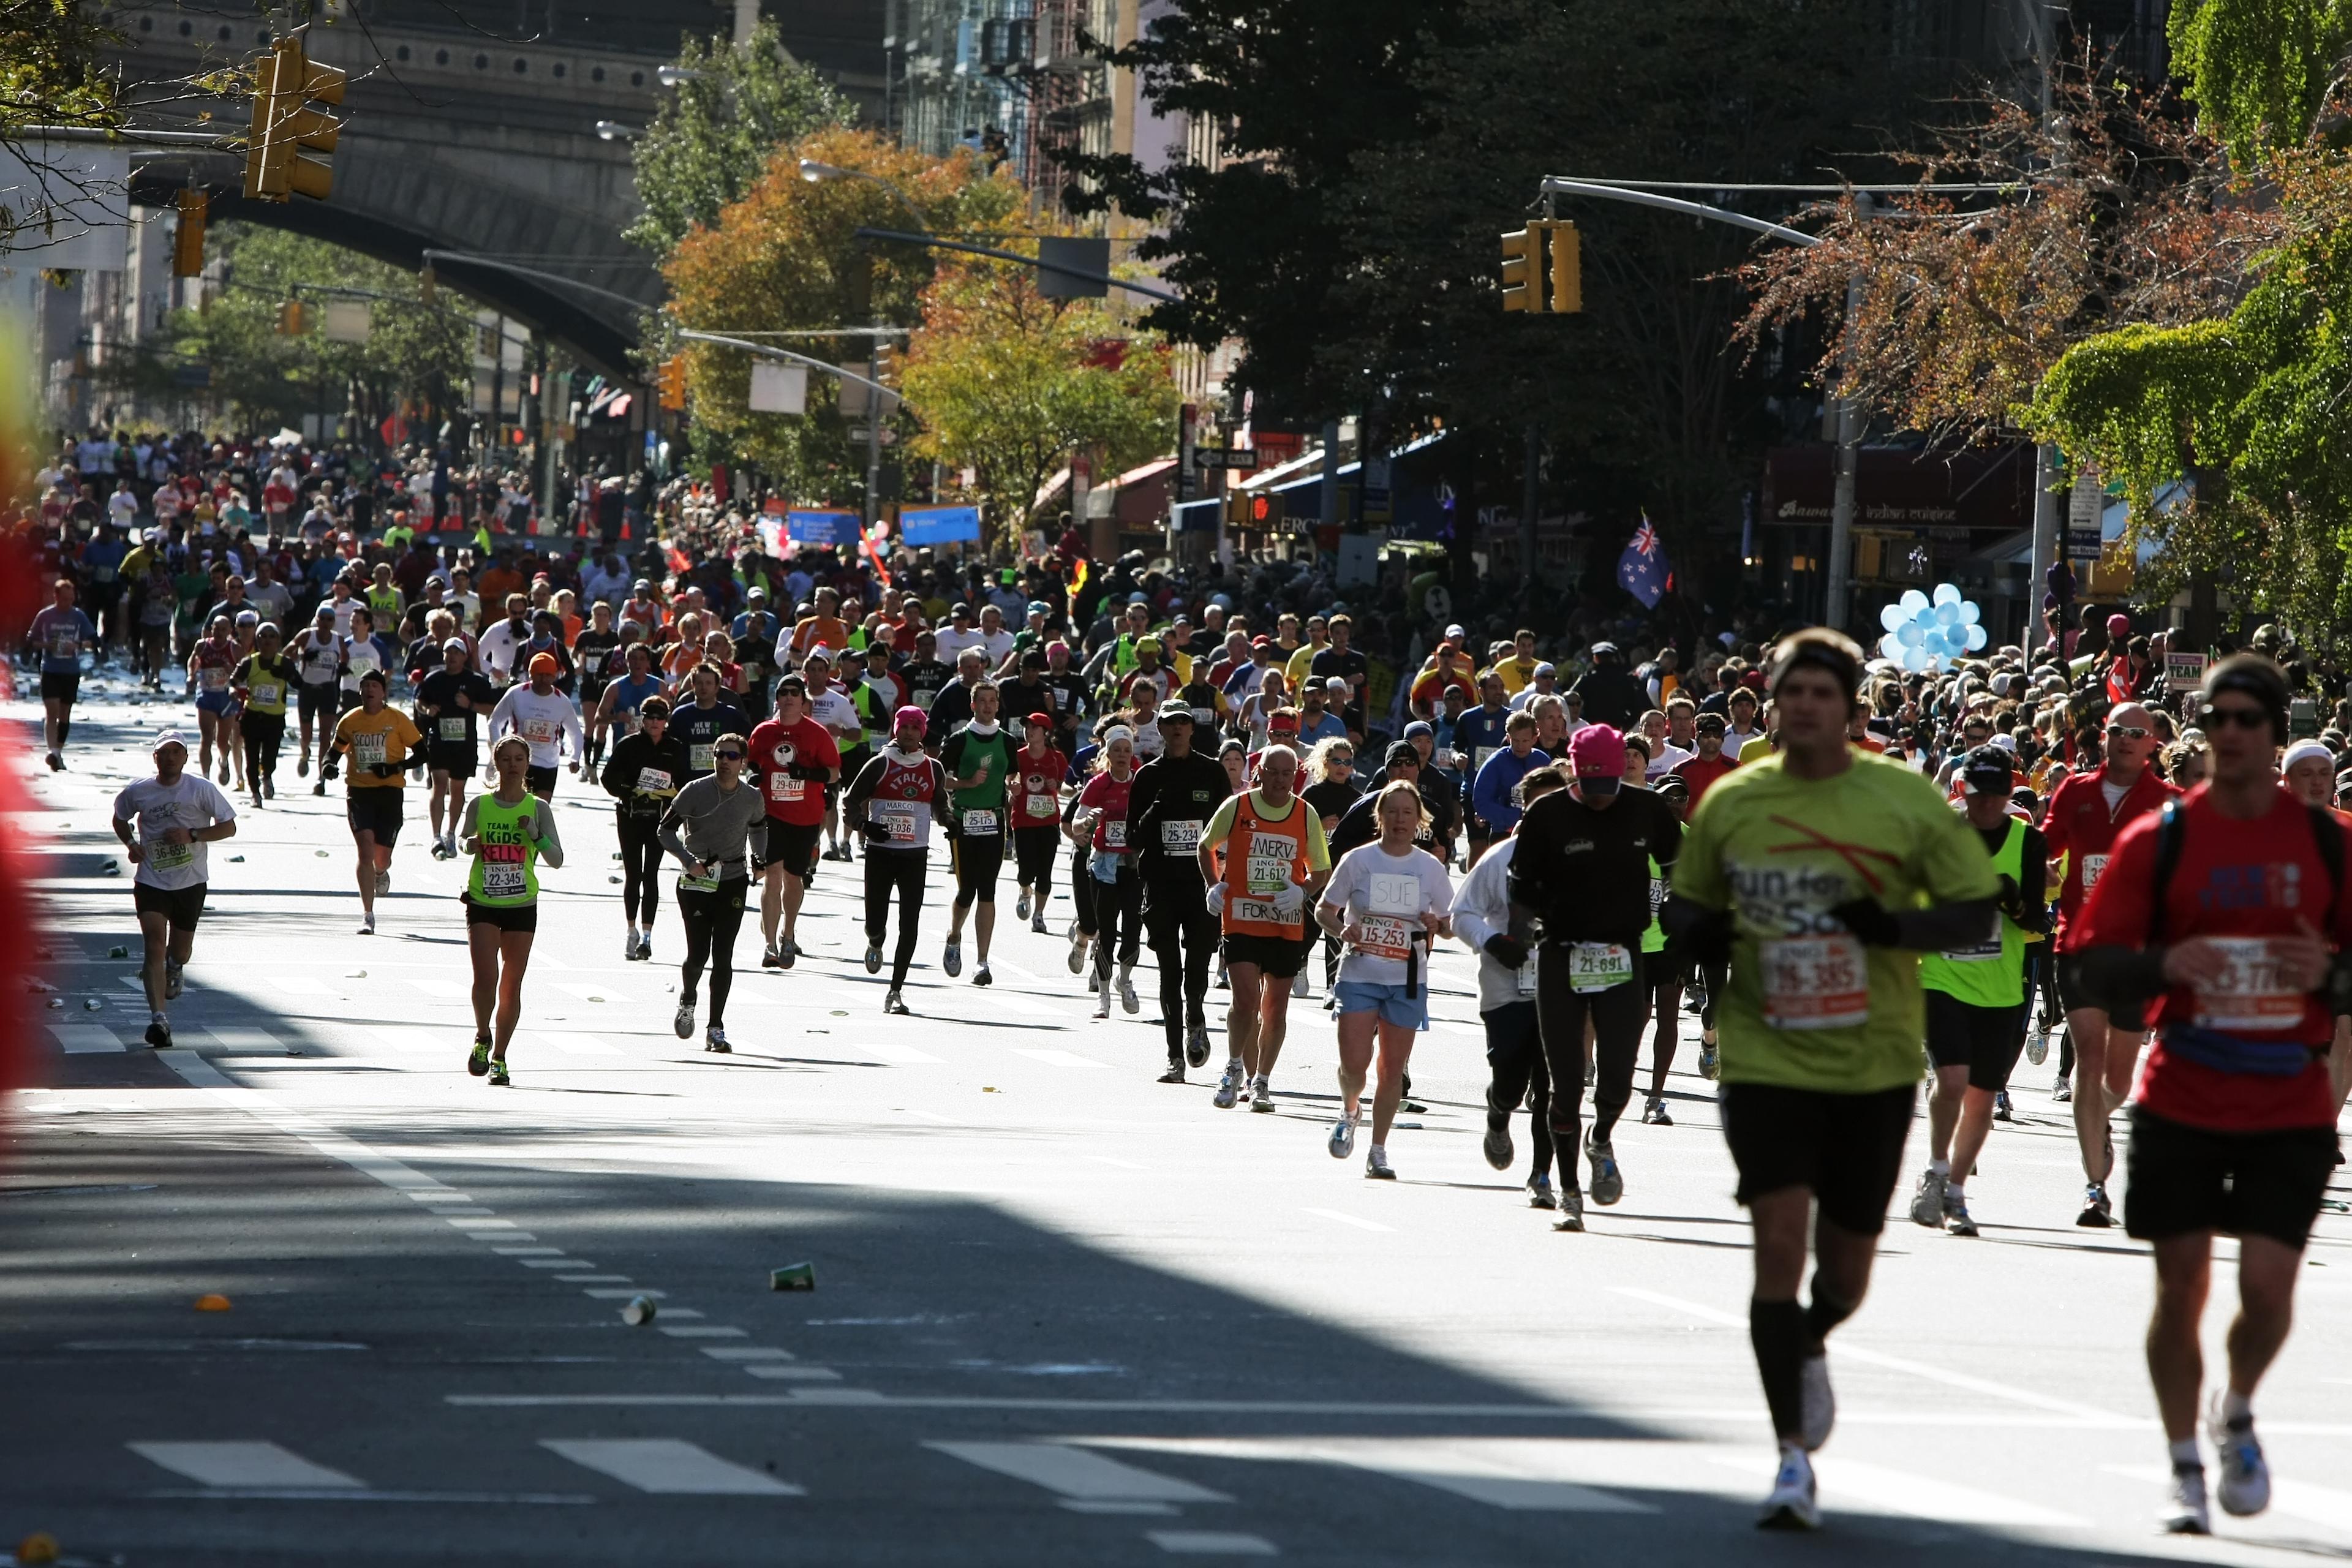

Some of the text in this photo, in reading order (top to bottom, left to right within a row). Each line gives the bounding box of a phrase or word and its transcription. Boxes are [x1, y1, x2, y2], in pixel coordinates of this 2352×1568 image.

[2169, 666, 2201, 678] TEAM
[355, 733, 386, 747] SCOTTY
[359, 752, 382, 763] 18-887
[776, 780, 801, 790] 29-677
[890, 773, 929, 792] ITALIA
[969, 816, 992, 825] 25-175
[1167, 829, 1199, 842] 25-234
[155, 844, 186, 860] 36-659
[483, 845, 526, 862] KELLY
[1253, 837, 1294, 858] MERV
[489, 872, 521, 886] 22-345
[1374, 881, 1414, 907] SUE
[1242, 902, 1269, 919] FOR
[1371, 919, 1392, 927] ING
[1364, 926, 1405, 947] 15-253
[1580, 956, 1623, 973] 21-691
